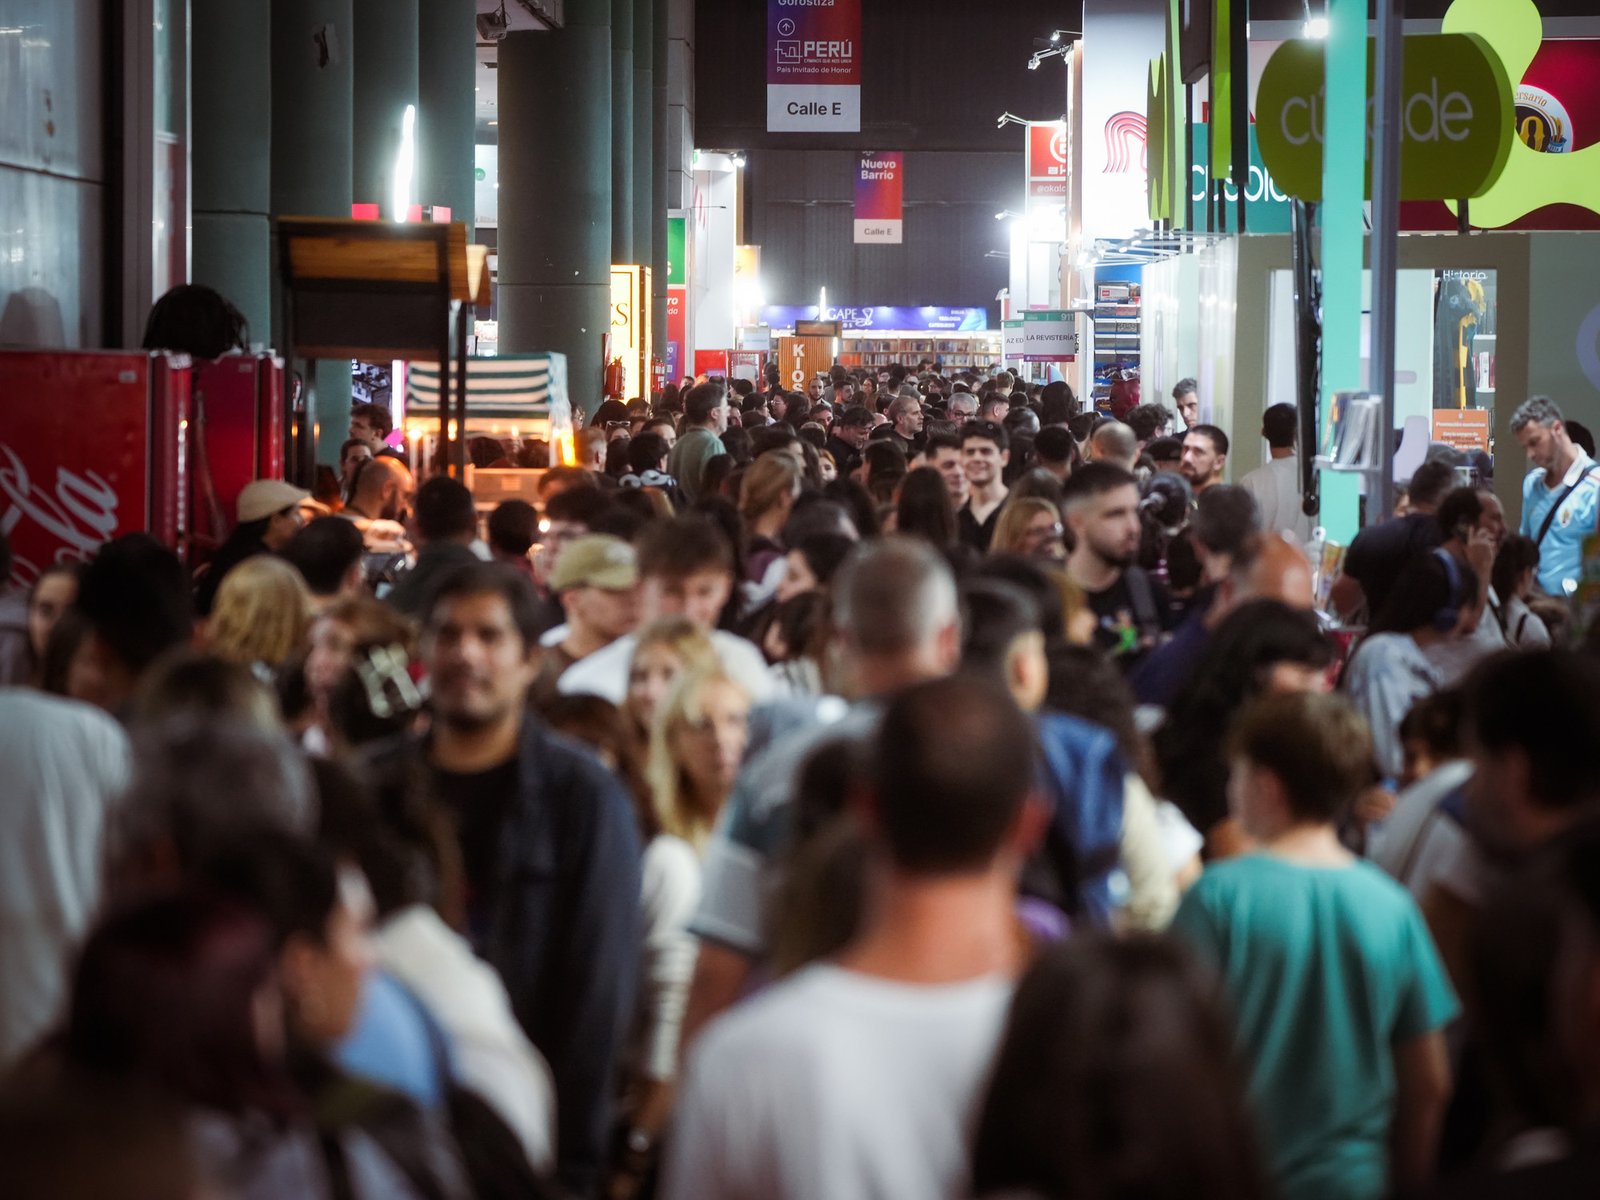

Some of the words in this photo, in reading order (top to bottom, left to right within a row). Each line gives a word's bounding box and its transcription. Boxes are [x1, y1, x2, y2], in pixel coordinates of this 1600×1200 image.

[804, 39, 852, 57] PERÚ
[787, 102, 827, 115] Calle
[832, 102, 841, 115] E
[861, 159, 896, 169] Nuevo
[861, 170, 894, 180] Barrio
[864, 228, 885, 236] Calle
[886, 228, 892, 236] E
[827, 307, 857, 321] GAPE
[1036, 333, 1074, 341] REVISTERÍA
